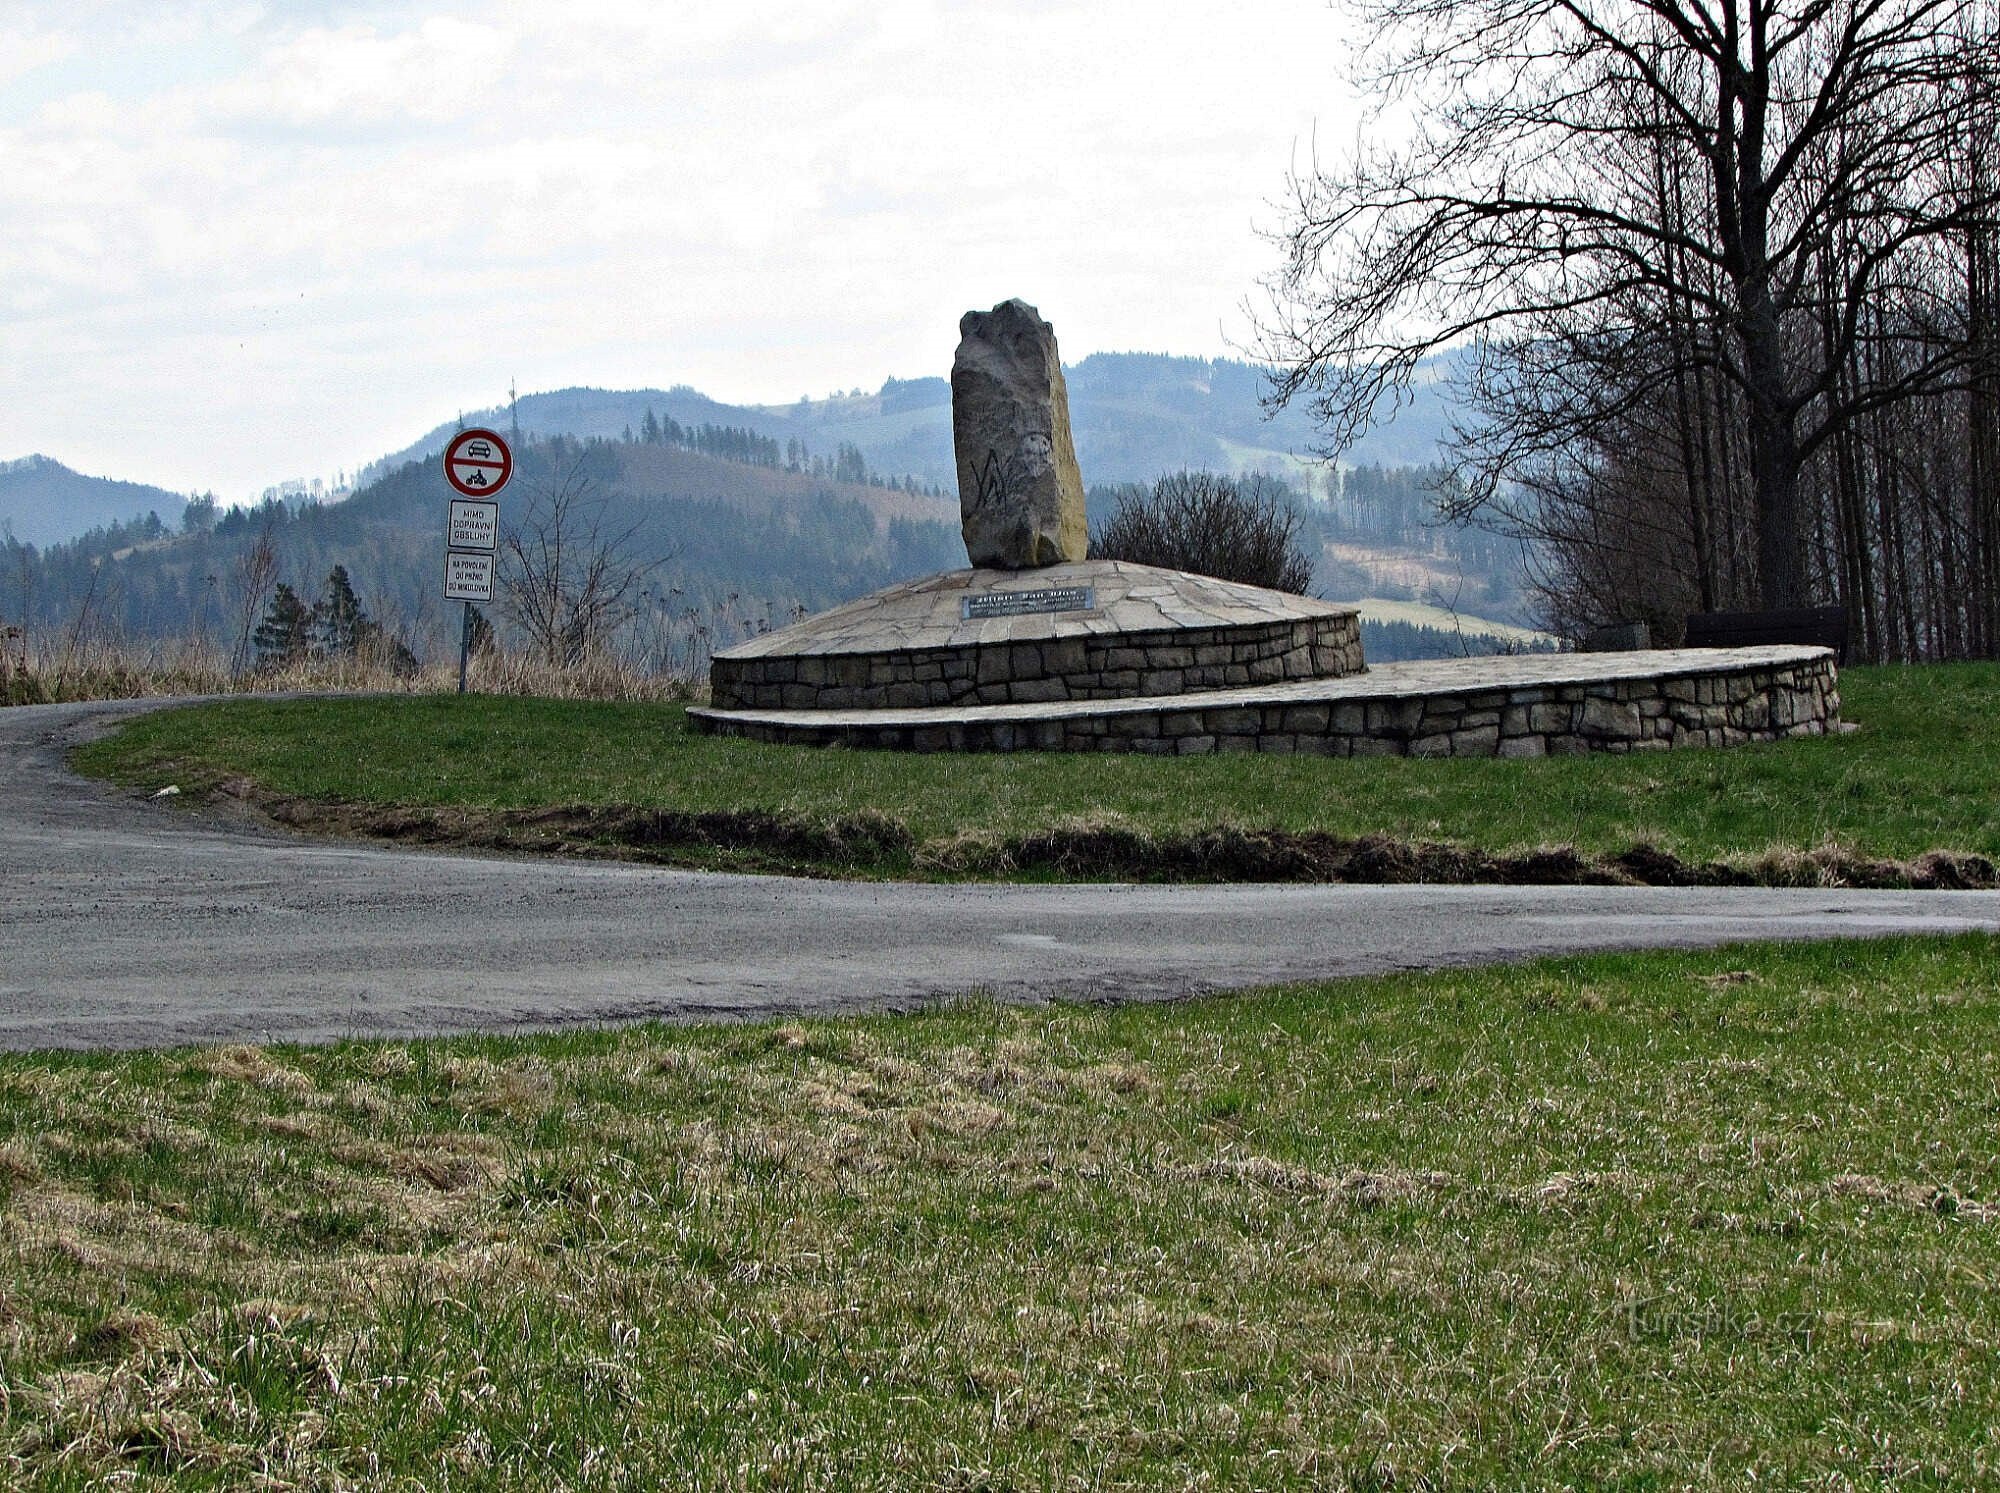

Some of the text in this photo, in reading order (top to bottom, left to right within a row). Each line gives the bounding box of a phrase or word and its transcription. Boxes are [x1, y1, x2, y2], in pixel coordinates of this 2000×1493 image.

[463, 510, 484, 519] MIMO
[453, 520, 493, 530] DOPRAVNÍ
[454, 531, 490, 541] OBSLUHY
